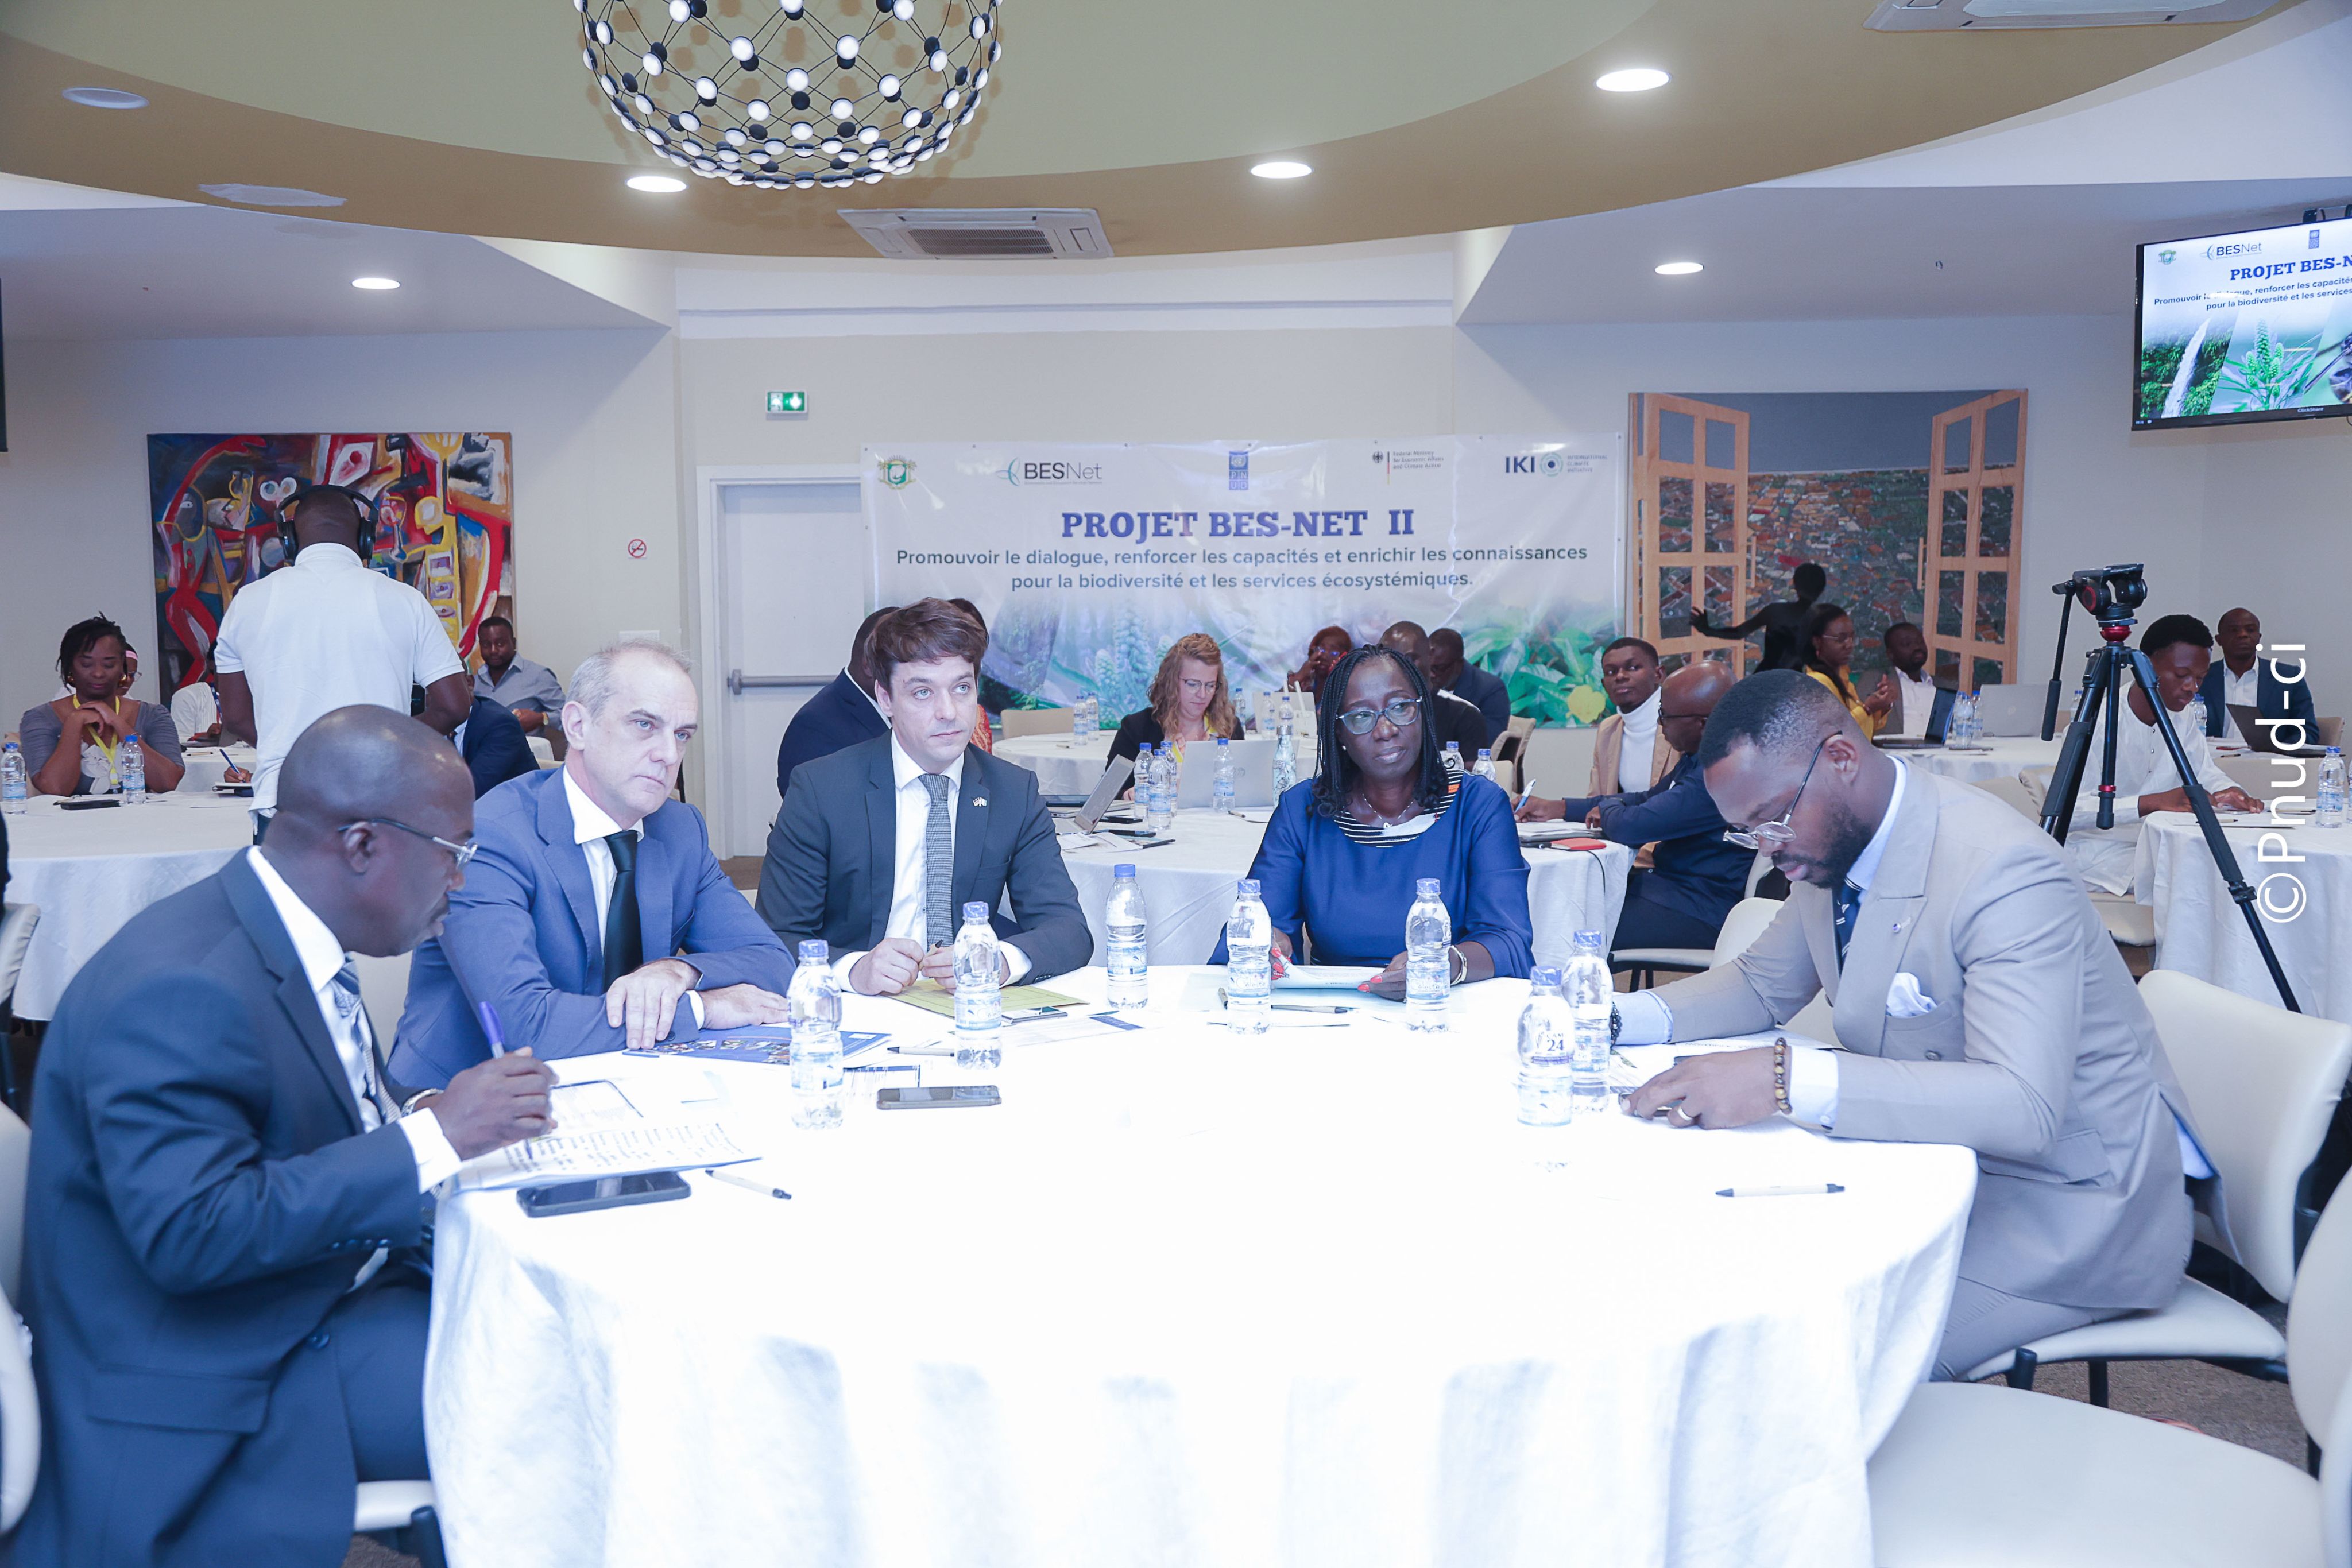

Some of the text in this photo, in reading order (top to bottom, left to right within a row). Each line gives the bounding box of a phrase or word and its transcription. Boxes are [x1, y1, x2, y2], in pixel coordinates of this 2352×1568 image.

[2216, 242, 2262, 256] BESNet
[2230, 262, 2295, 280] PROJET
[2154, 293, 2202, 305] Promouvoir
[2255, 285, 2295, 293] renforcer
[2206, 302, 2226, 311] pour
[2238, 294, 2288, 306] biodiversité
[1024, 462, 1102, 479] BESNet
[1506, 456, 1535, 473] IKI
[1062, 509, 1414, 544] PROJET BES-NET II
[897, 545, 1587, 567] Promouvoir le dialogue, renforcer les capacités et enrichir les connaissances
[1012, 571, 1473, 591] pour la biodiversité et les services écosystémiques.
[1547, 1039, 1564, 1051] 24
